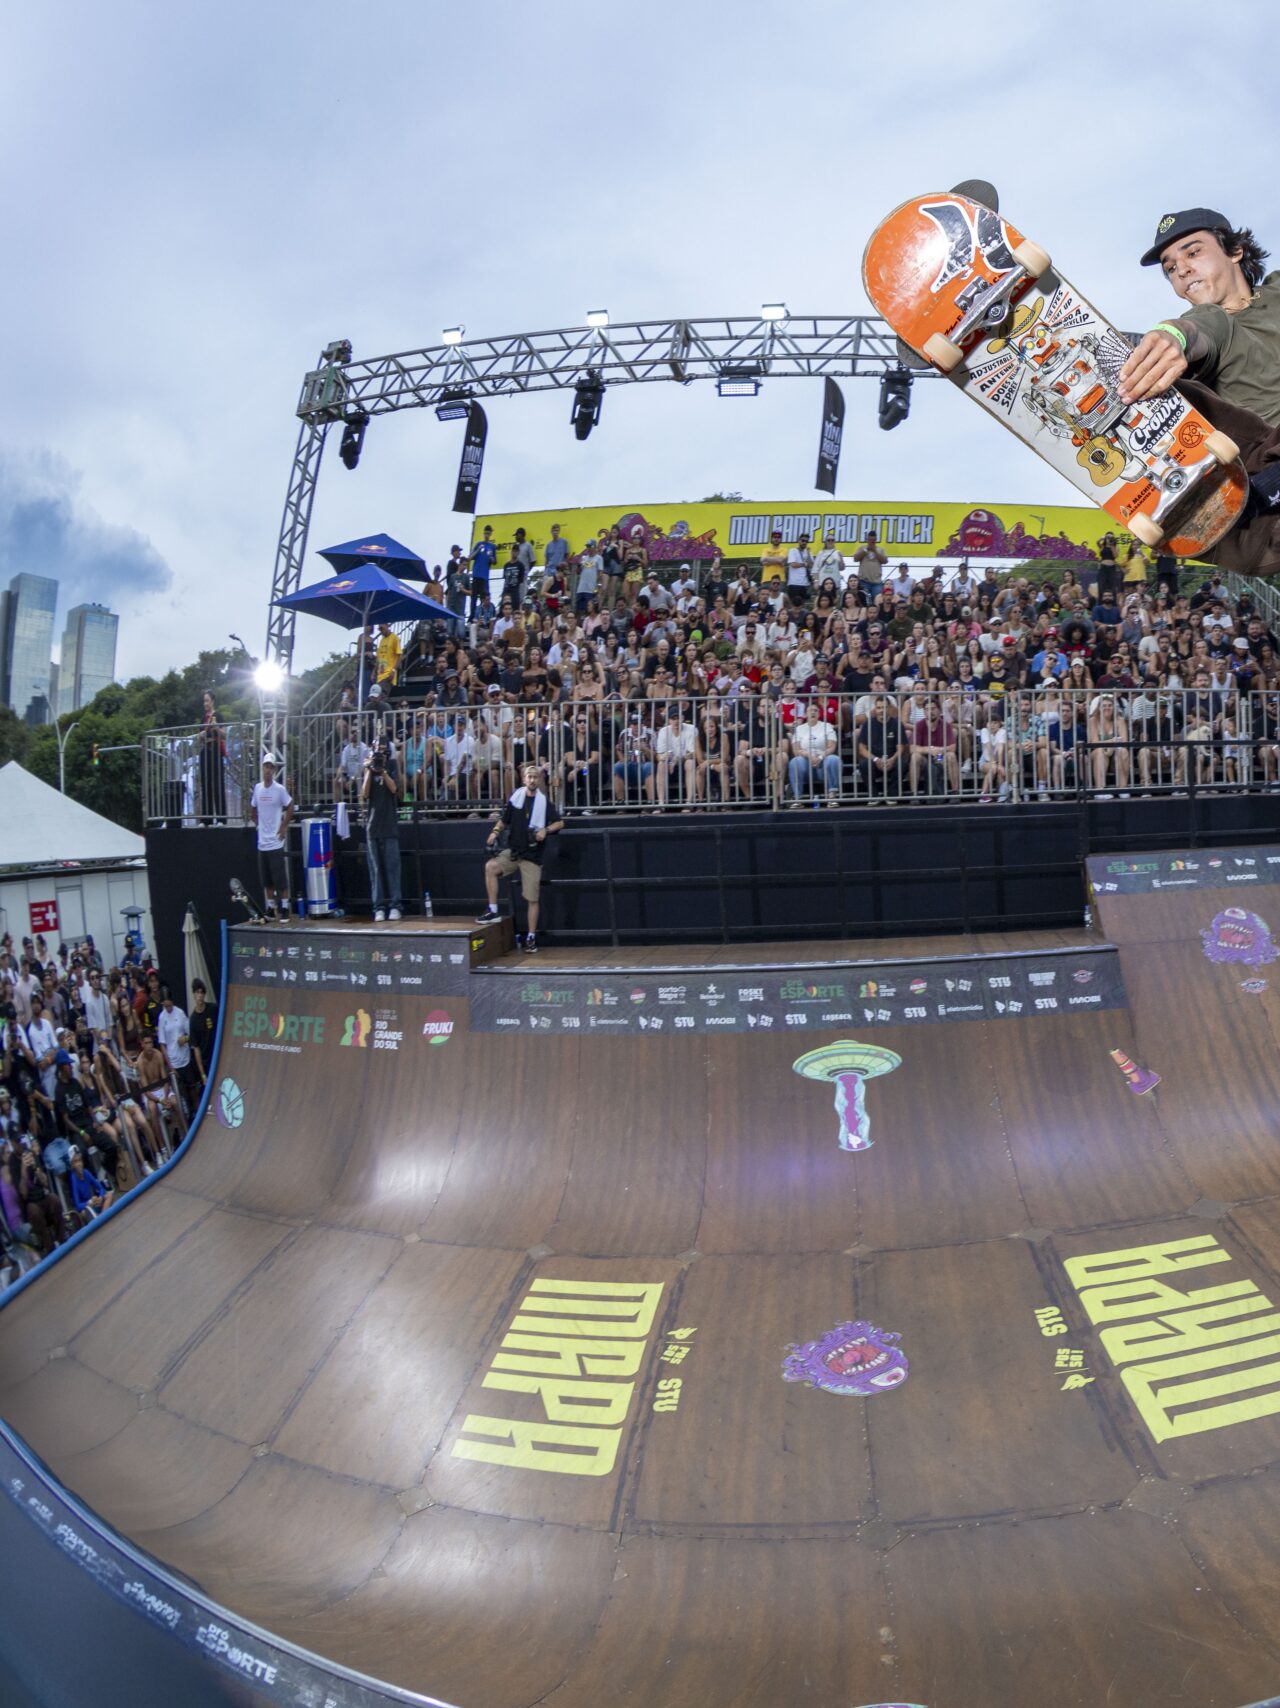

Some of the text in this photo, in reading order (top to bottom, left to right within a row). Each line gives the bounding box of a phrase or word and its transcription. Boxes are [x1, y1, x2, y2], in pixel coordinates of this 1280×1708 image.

[1052, 290, 1063, 309] EYES
[970, 354, 1013, 380] ADJUSTABLE
[980, 363, 1014, 392] ANTENNA
[991, 380, 1011, 402] DOES
[1001, 381, 1018, 407] SPREE
[1142, 426, 1169, 454] CORNER
[1168, 406, 1185, 429] SHOP
[1132, 483, 1153, 504] MACHIN
[729, 514, 934, 545] MINI RAMP PRO ATTACK
[988, 976, 1011, 988] STU
[780, 985, 844, 999] ESPORTE
[1035, 997, 1057, 1009] STU
[562, 1016, 580, 1027] STU
[674, 1016, 695, 1028] STU
[785, 1013, 807, 1025] STU
[904, 1007, 926, 1019] STU
[232, 1012, 326, 1044] ESPORTE
[375, 1020, 388, 1030] RIO
[423, 1021, 454, 1034] FRUKI
[373, 1040, 398, 1050] DO SUL
[375, 1030, 403, 1041] GRANDE
[1034, 1305, 1068, 1337] STU
[670, 1346, 691, 1365] POS
[1055, 1348, 1070, 1367] POS
[652, 1377, 683, 1412] STU
[208, 1623, 229, 1641] pró
[195, 1626, 277, 1684] ESPORTE
